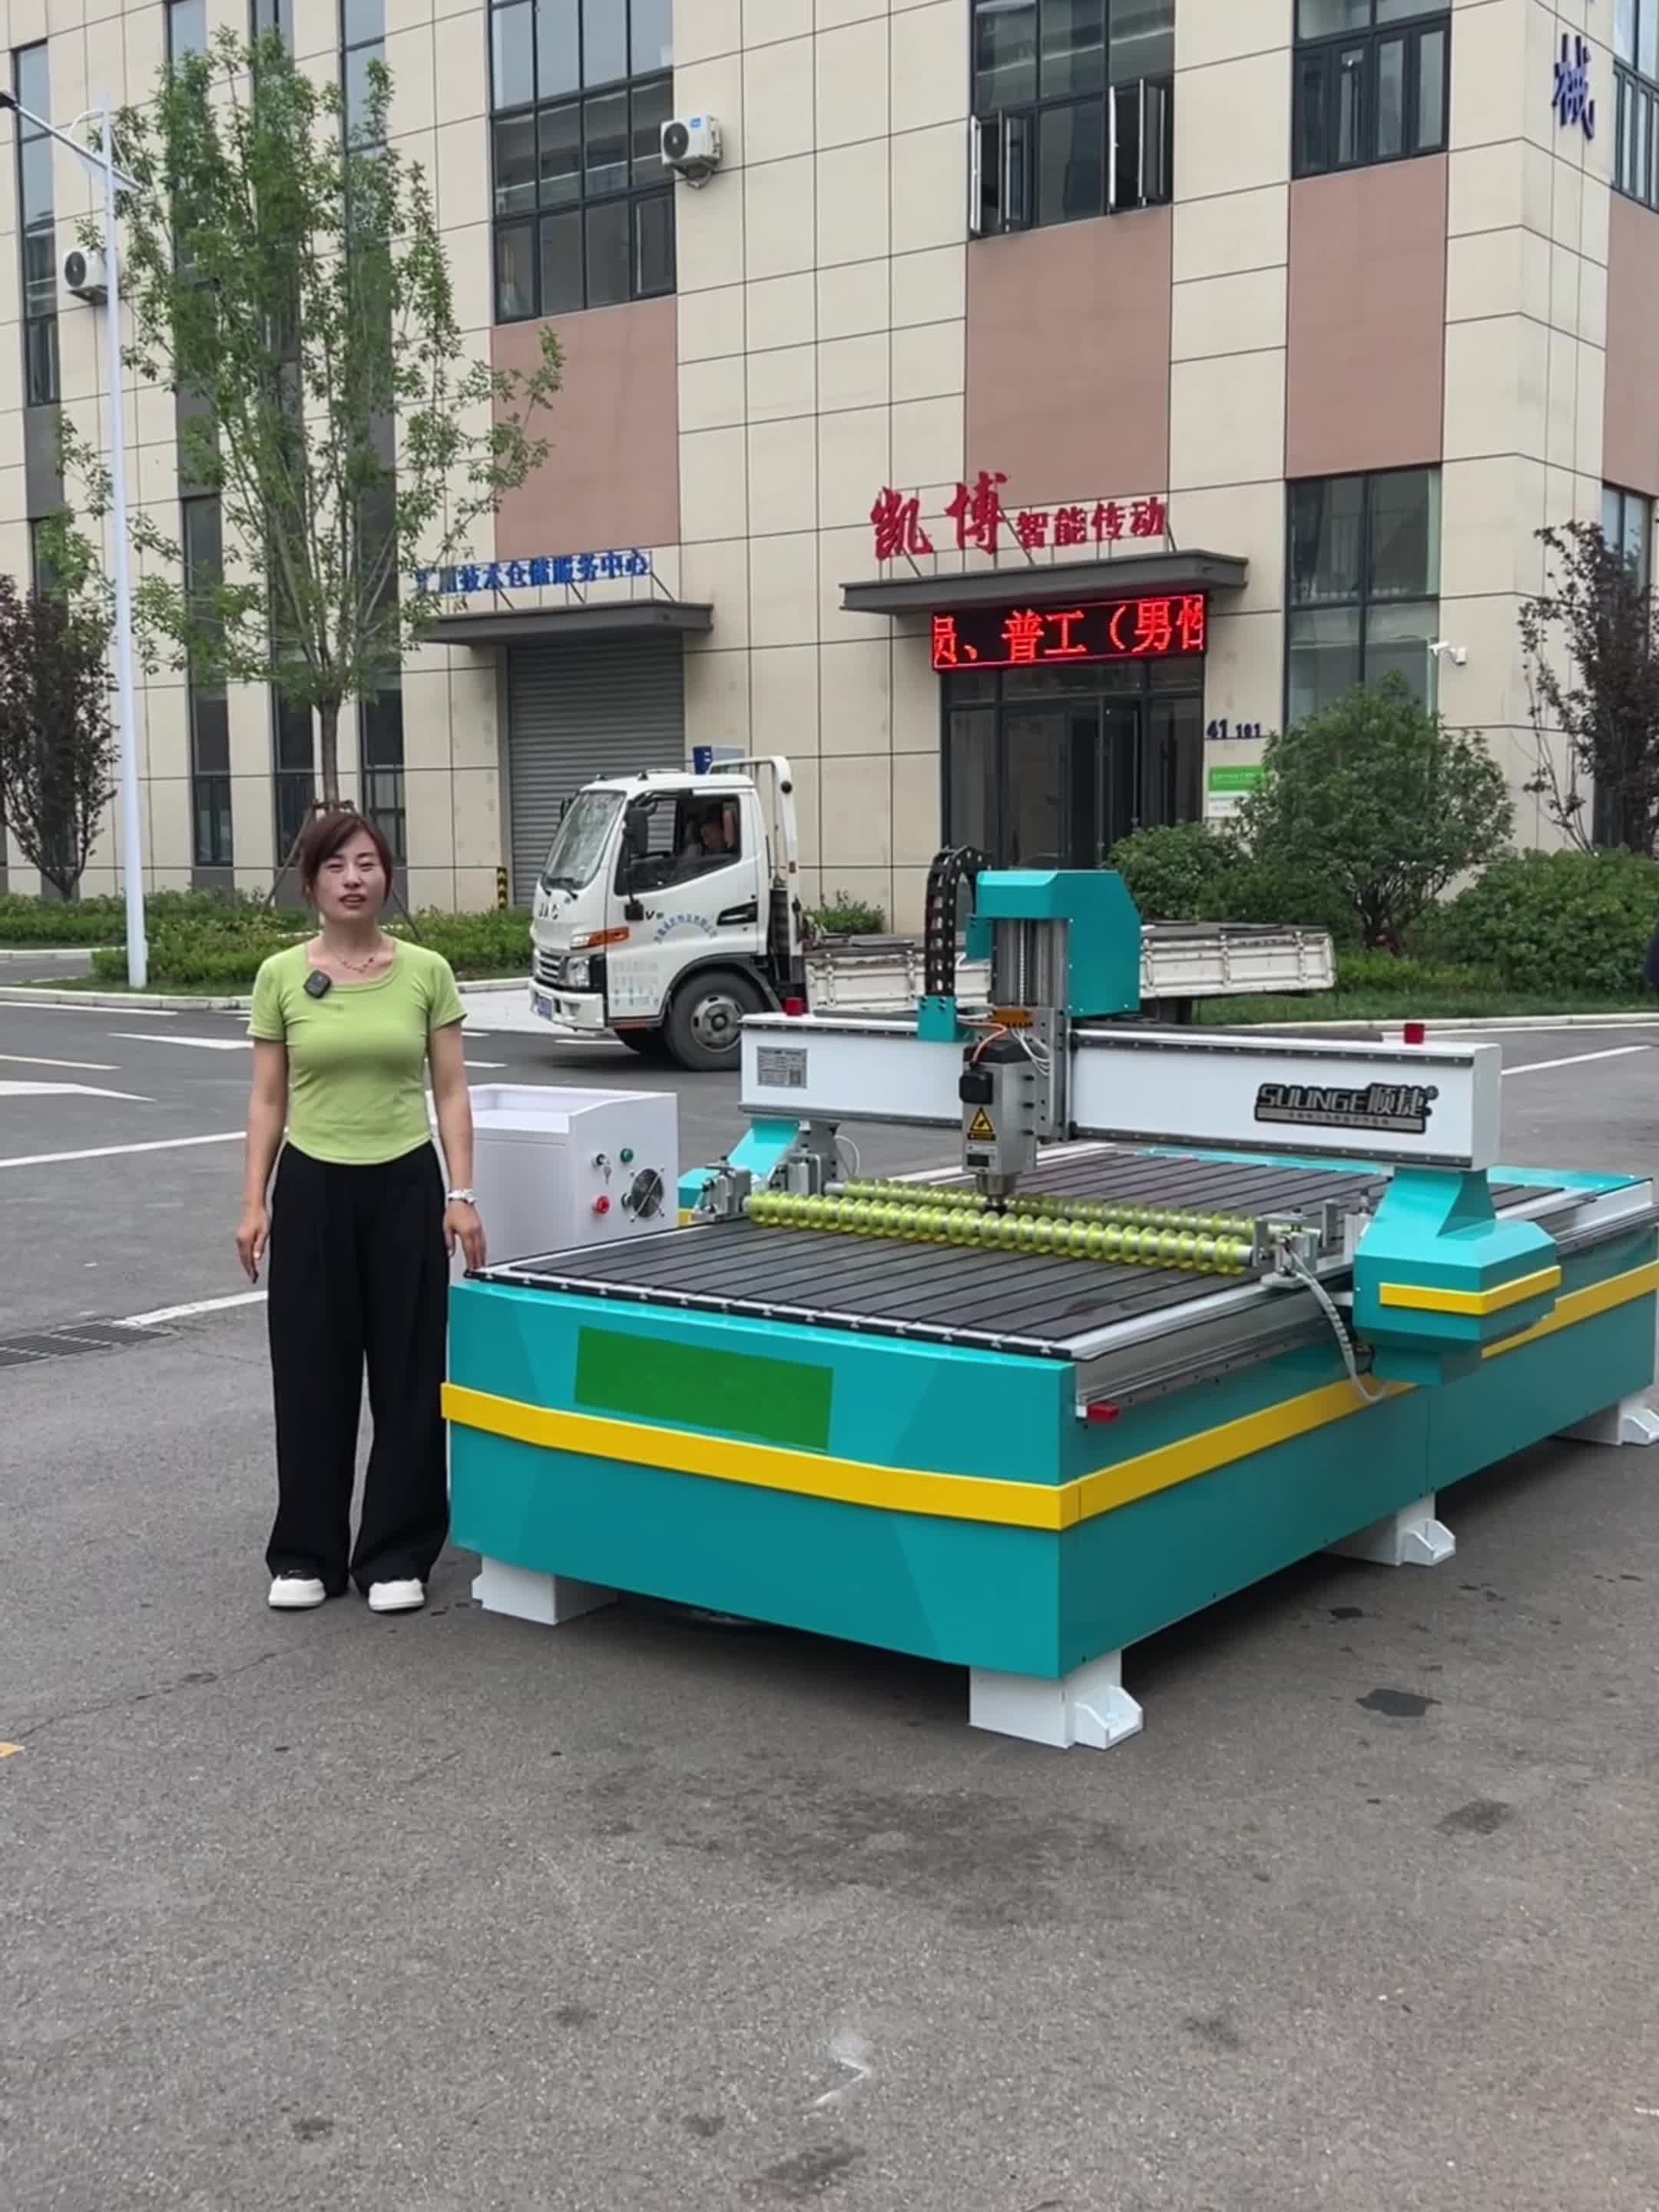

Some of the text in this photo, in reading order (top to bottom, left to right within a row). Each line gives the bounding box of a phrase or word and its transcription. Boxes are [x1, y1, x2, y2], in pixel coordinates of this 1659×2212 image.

[870, 470, 1168, 561] 凯博 智能传动
